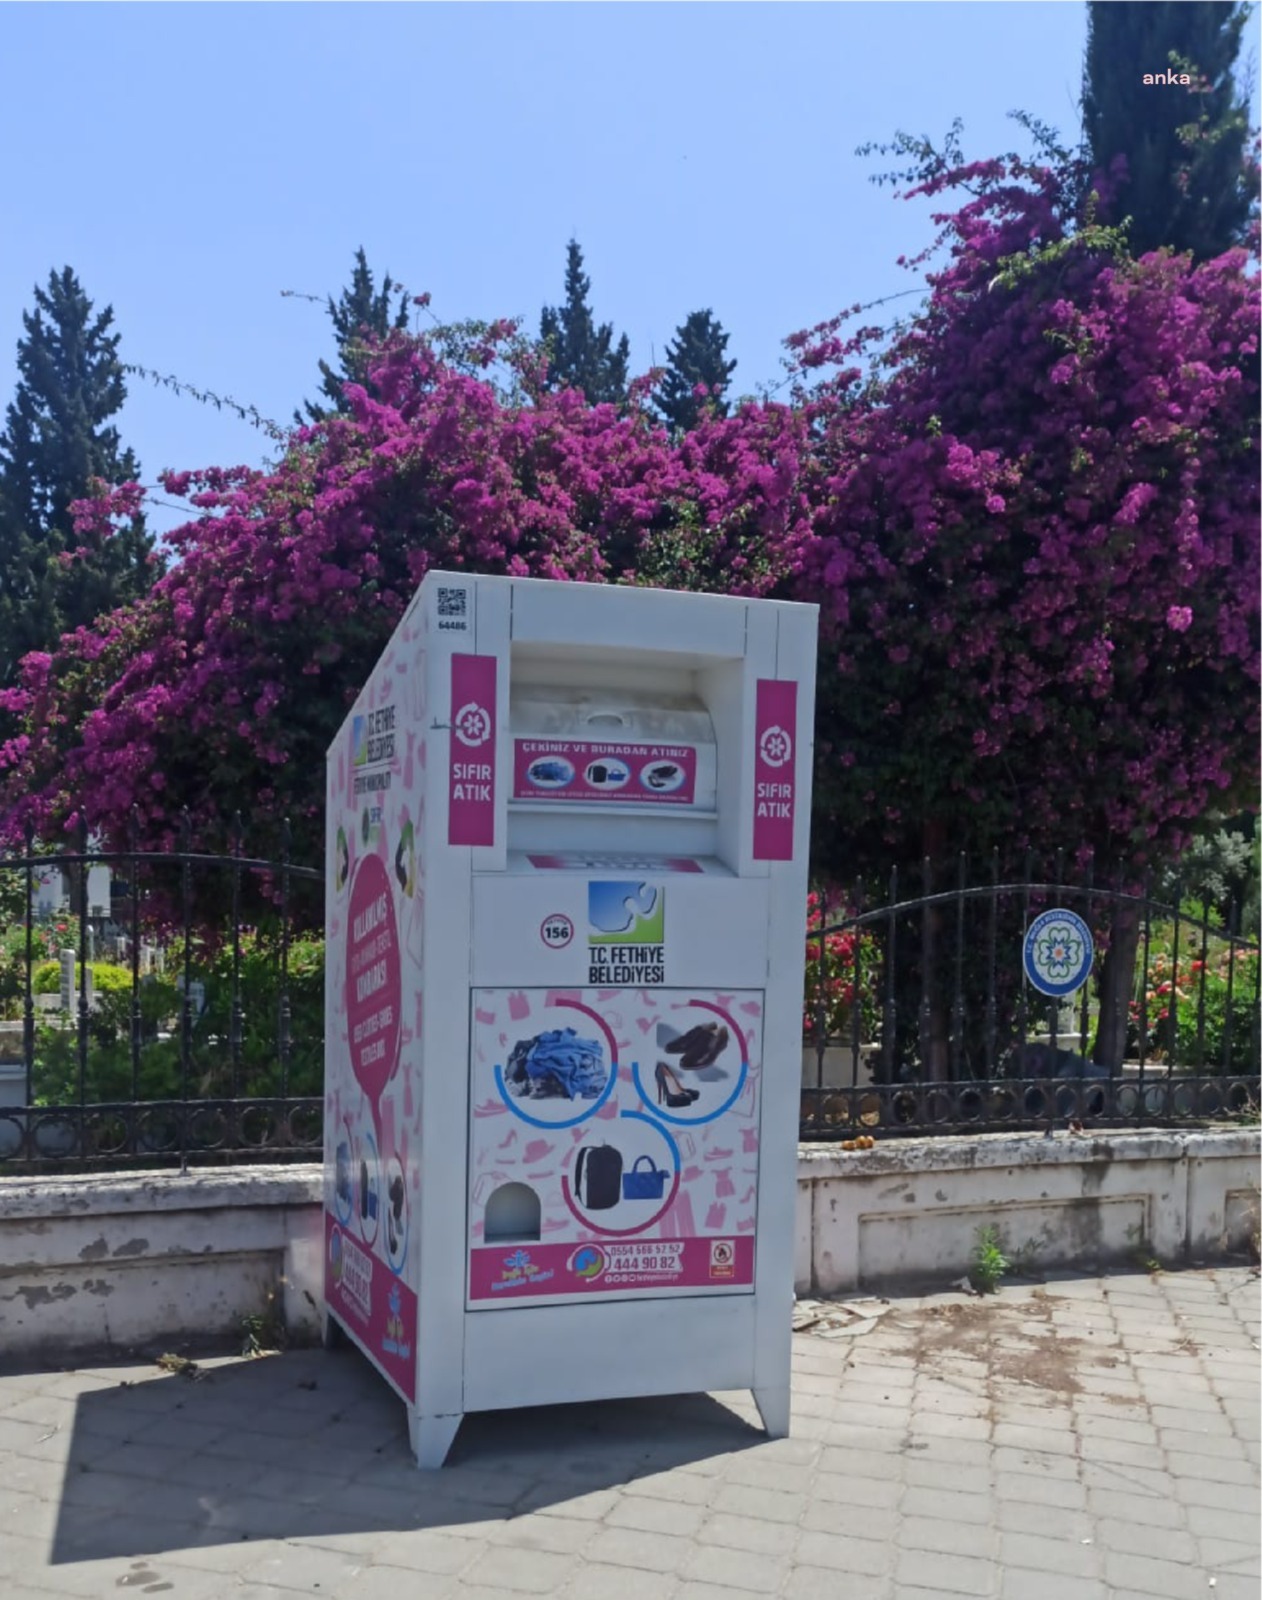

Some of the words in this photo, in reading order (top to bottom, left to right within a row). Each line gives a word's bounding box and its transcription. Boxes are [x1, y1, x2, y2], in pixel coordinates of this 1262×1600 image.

[573, 743, 587, 753] VE
[591, 744, 648, 756] BURADAN
[453, 763, 492, 780] SIFIR
[453, 783, 492, 801] ATIK
[757, 782, 792, 799] SIFIR
[757, 802, 792, 818] ATIK
[545, 926, 569, 939] 156
[611, 946, 665, 964] FETHİYE
[588, 965, 665, 984] BELEDİYESİ
[614, 1257, 639, 1270] 444
[642, 1256, 657, 1269] 90
[660, 1256, 675, 1269] 82
